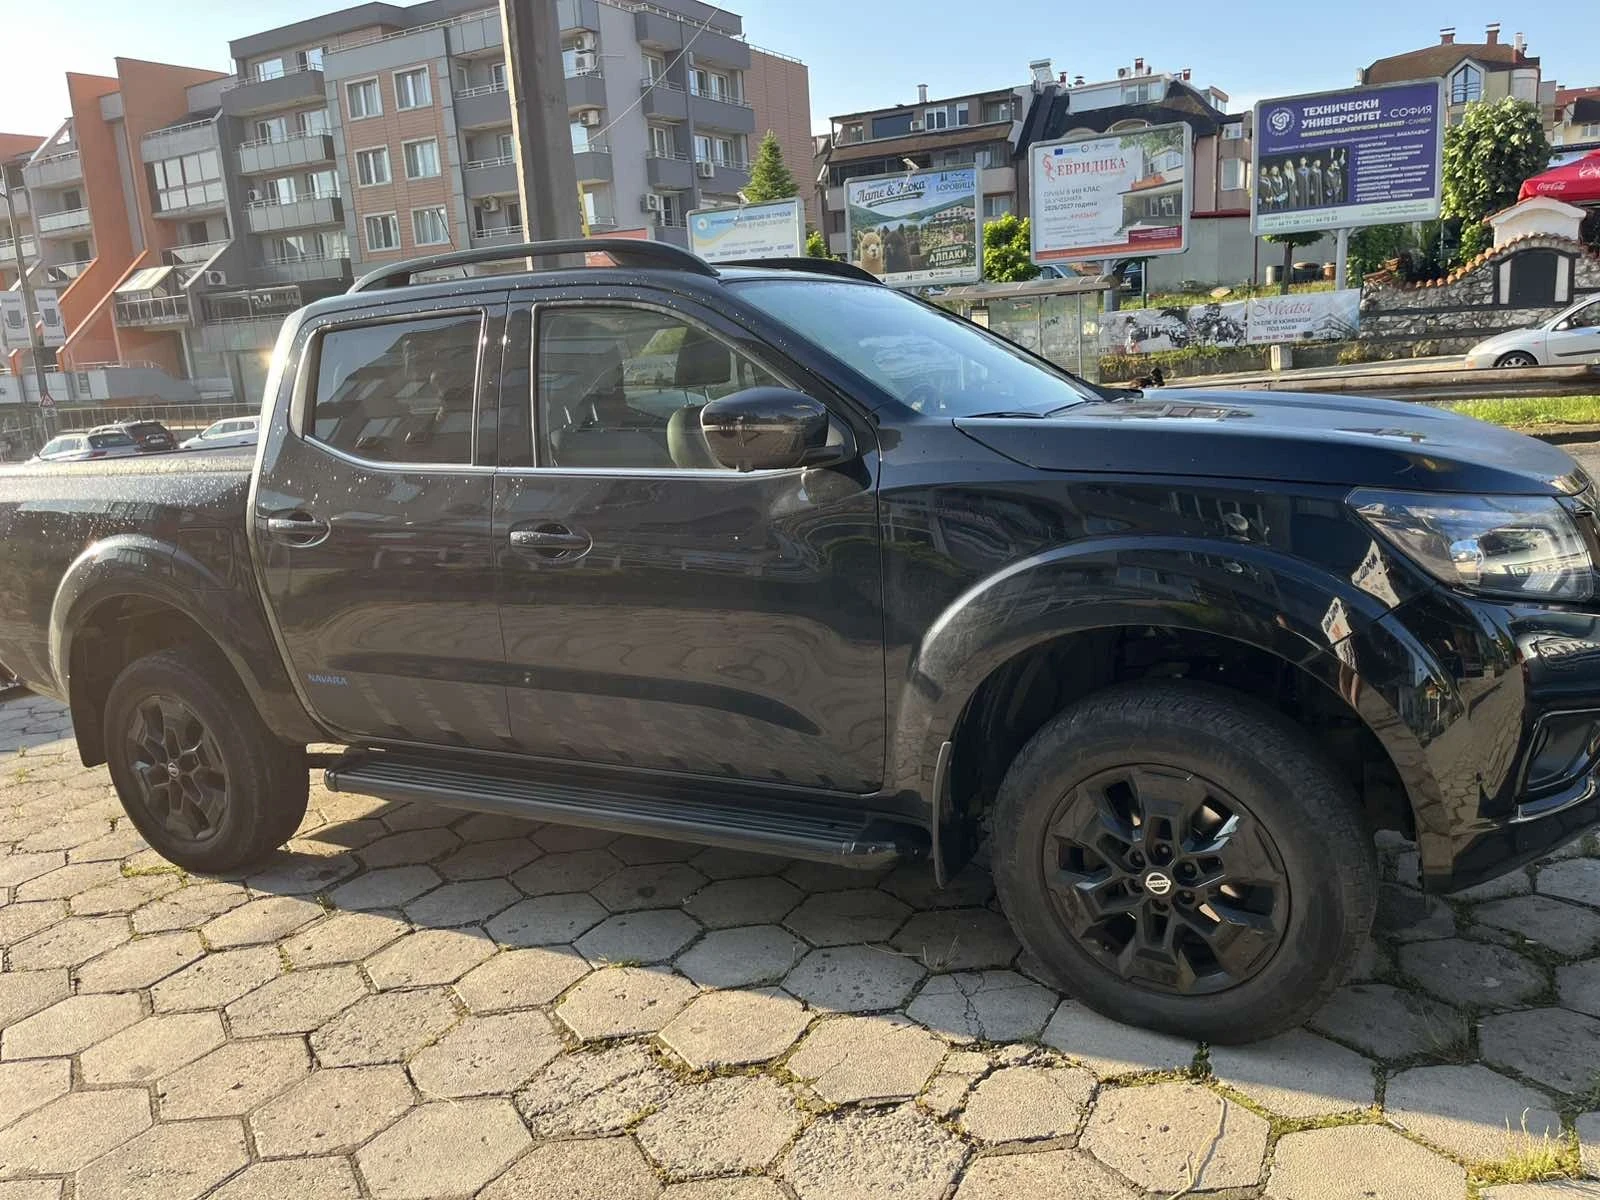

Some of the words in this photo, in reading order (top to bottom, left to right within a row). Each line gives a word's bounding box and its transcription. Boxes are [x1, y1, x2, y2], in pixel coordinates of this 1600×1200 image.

[1303, 99, 1379, 117] ТЕХНИЧЕСКИ
[1301, 110, 1382, 129] УНИВЕРСИТЕТ
[1390, 105, 1432, 119] СОФИЯ
[1057, 157, 1127, 177] ЕВРИДИКА
[856, 188, 886, 204] Лате
[886, 184, 896, 196] &
[1083, 185, 1102, 193] КЛАС
[1536, 181, 1567, 191] Coca-Cola
[929, 249, 967, 262] АЛПАКИ
[307, 673, 348, 687] NAVARA
